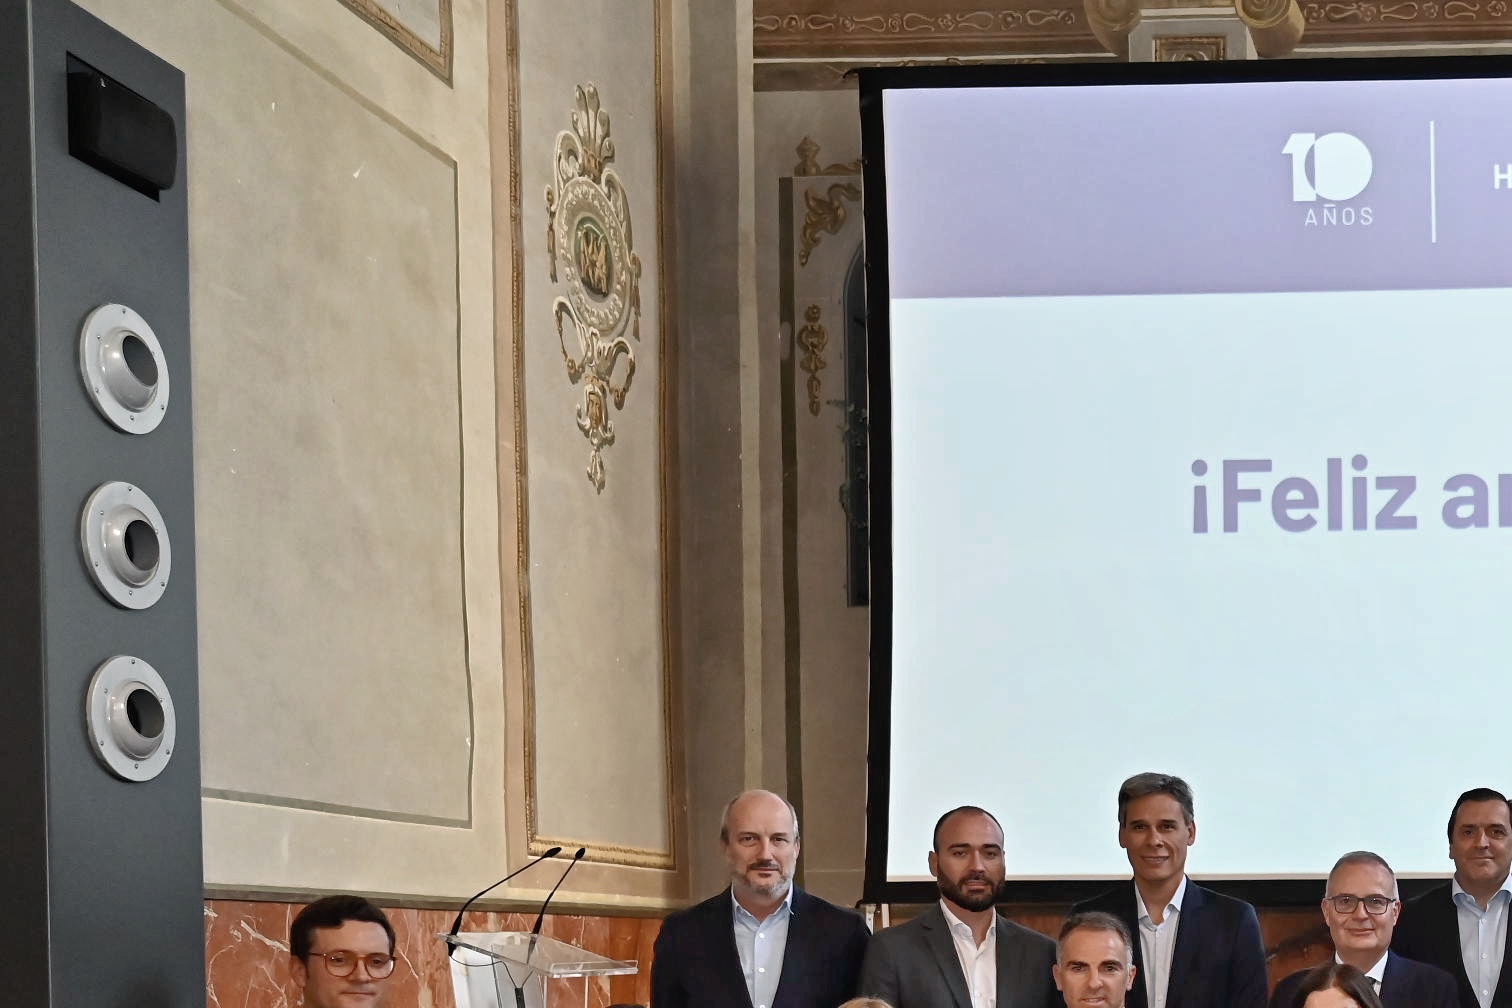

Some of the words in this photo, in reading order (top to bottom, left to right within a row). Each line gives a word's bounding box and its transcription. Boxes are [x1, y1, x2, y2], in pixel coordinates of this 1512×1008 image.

[1281, 132, 1373, 202] 10
[1303, 203, 1374, 227] AÑOS
[1190, 454, 1419, 535] ¡Feliz
